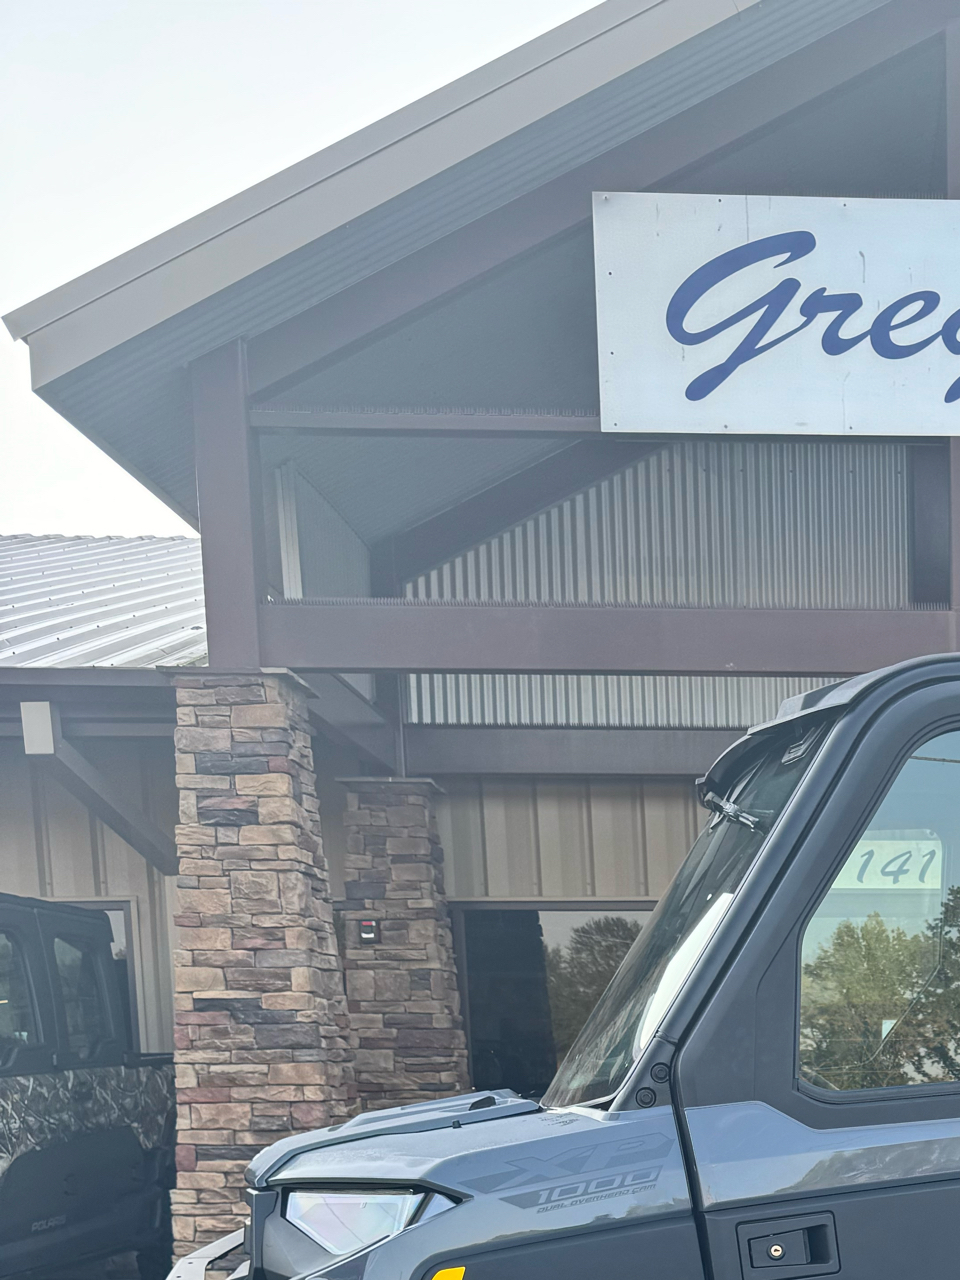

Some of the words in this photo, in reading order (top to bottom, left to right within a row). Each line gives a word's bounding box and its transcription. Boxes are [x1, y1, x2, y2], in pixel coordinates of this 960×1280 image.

[856, 849, 936, 884] 141
[486, 1132, 673, 1194] XP
[536, 1203, 568, 1214] DUAL
[571, 1190, 630, 1207] OVERHEAD
[632, 1184, 657, 1195] CAM
[537, 1165, 662, 1204] 1000
